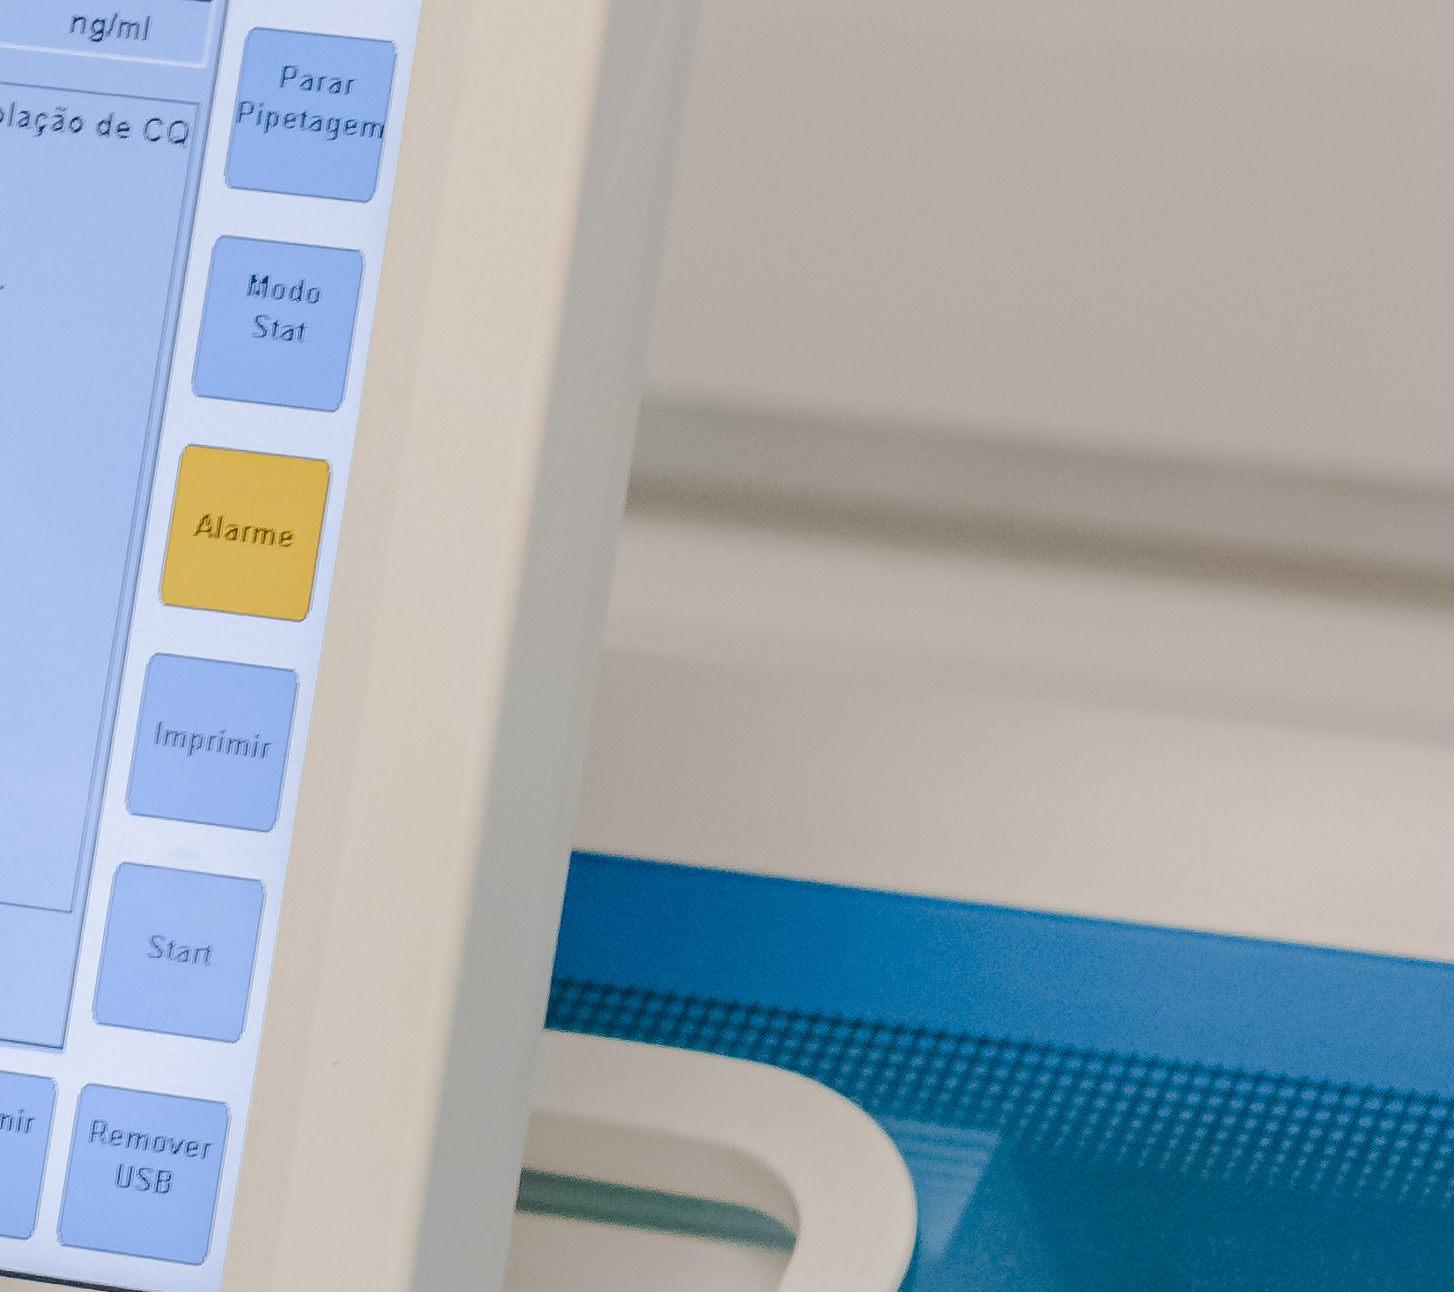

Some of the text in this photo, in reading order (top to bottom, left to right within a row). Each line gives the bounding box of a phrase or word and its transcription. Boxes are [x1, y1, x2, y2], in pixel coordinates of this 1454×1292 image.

[69, 10, 155, 44] ng/ml
[278, 64, 356, 96] Parar
[95, 109, 134, 141] de
[143, 115, 191, 149] CQ
[236, 98, 386, 143] Pipetagem
[245, 272, 323, 306] Modo
[252, 313, 309, 345] Stat
[192, 511, 298, 549] Alarme
[152, 720, 274, 761] Imprimir
[147, 932, 214, 968] Start
[87, 1117, 215, 1161] Remover
[113, 1162, 175, 1197] USB
